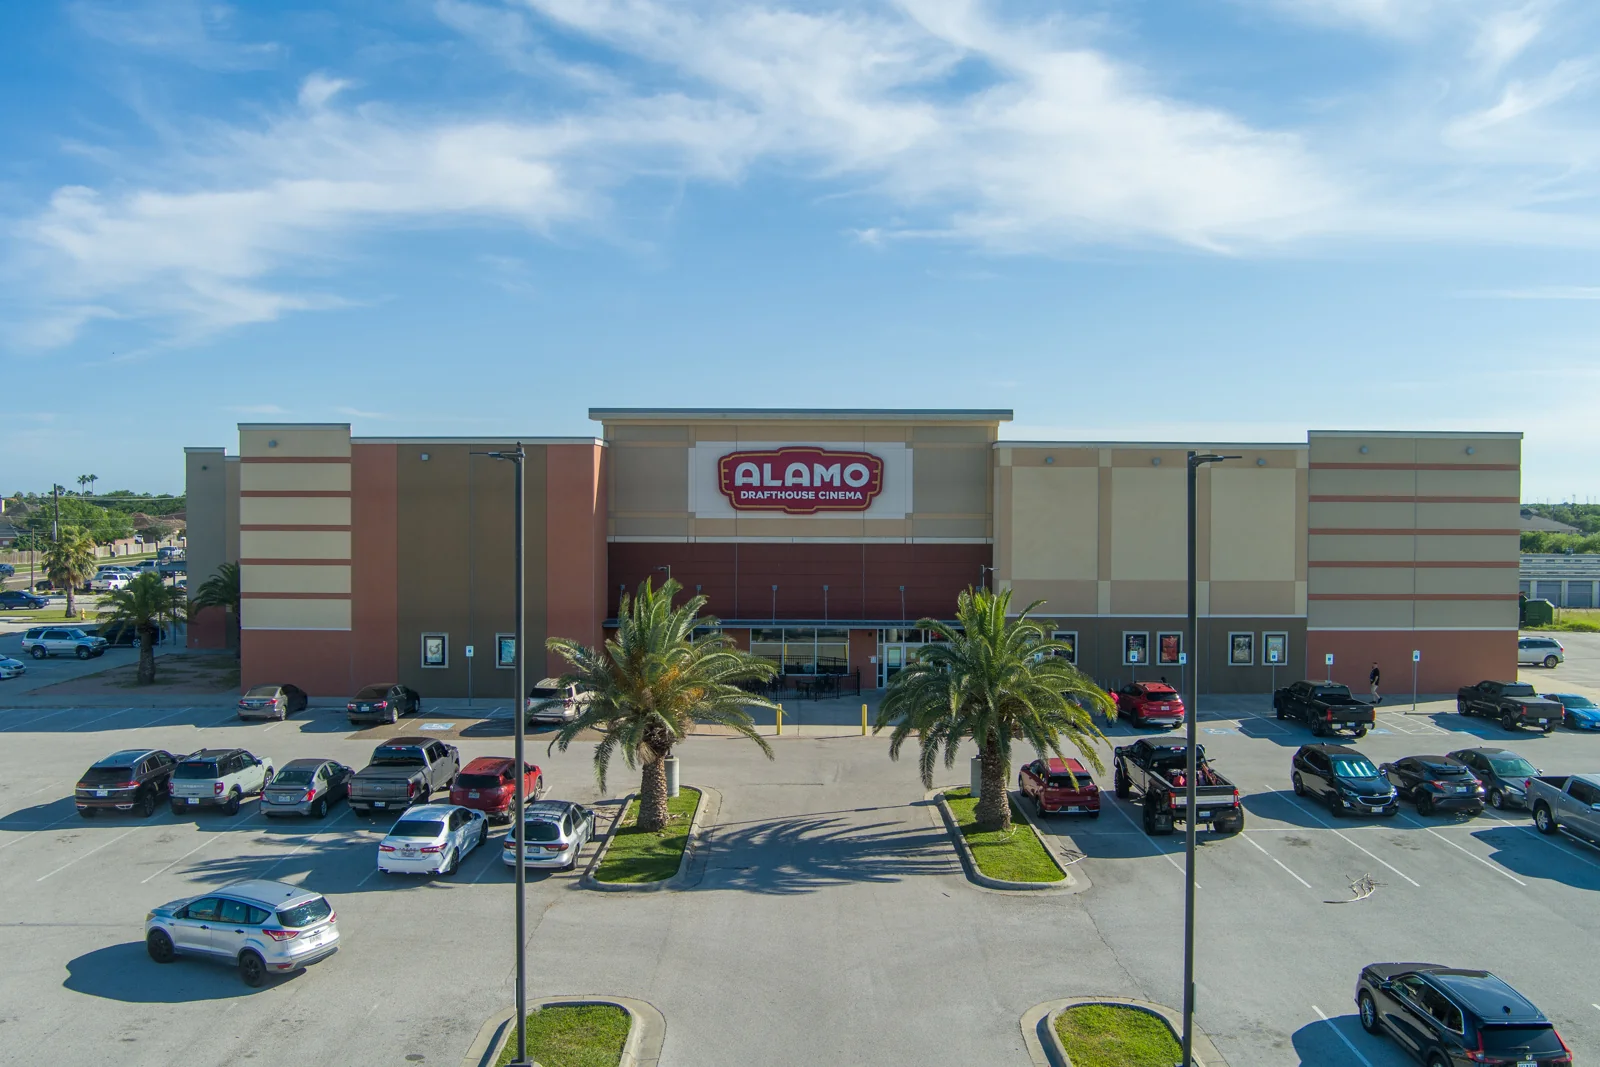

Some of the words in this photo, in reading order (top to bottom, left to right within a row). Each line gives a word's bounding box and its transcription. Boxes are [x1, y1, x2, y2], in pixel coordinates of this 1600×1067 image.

[734, 462, 870, 488] ALAMO
[740, 490, 815, 500] DRAFTHOUSE
[818, 491, 863, 500] CINEMA
